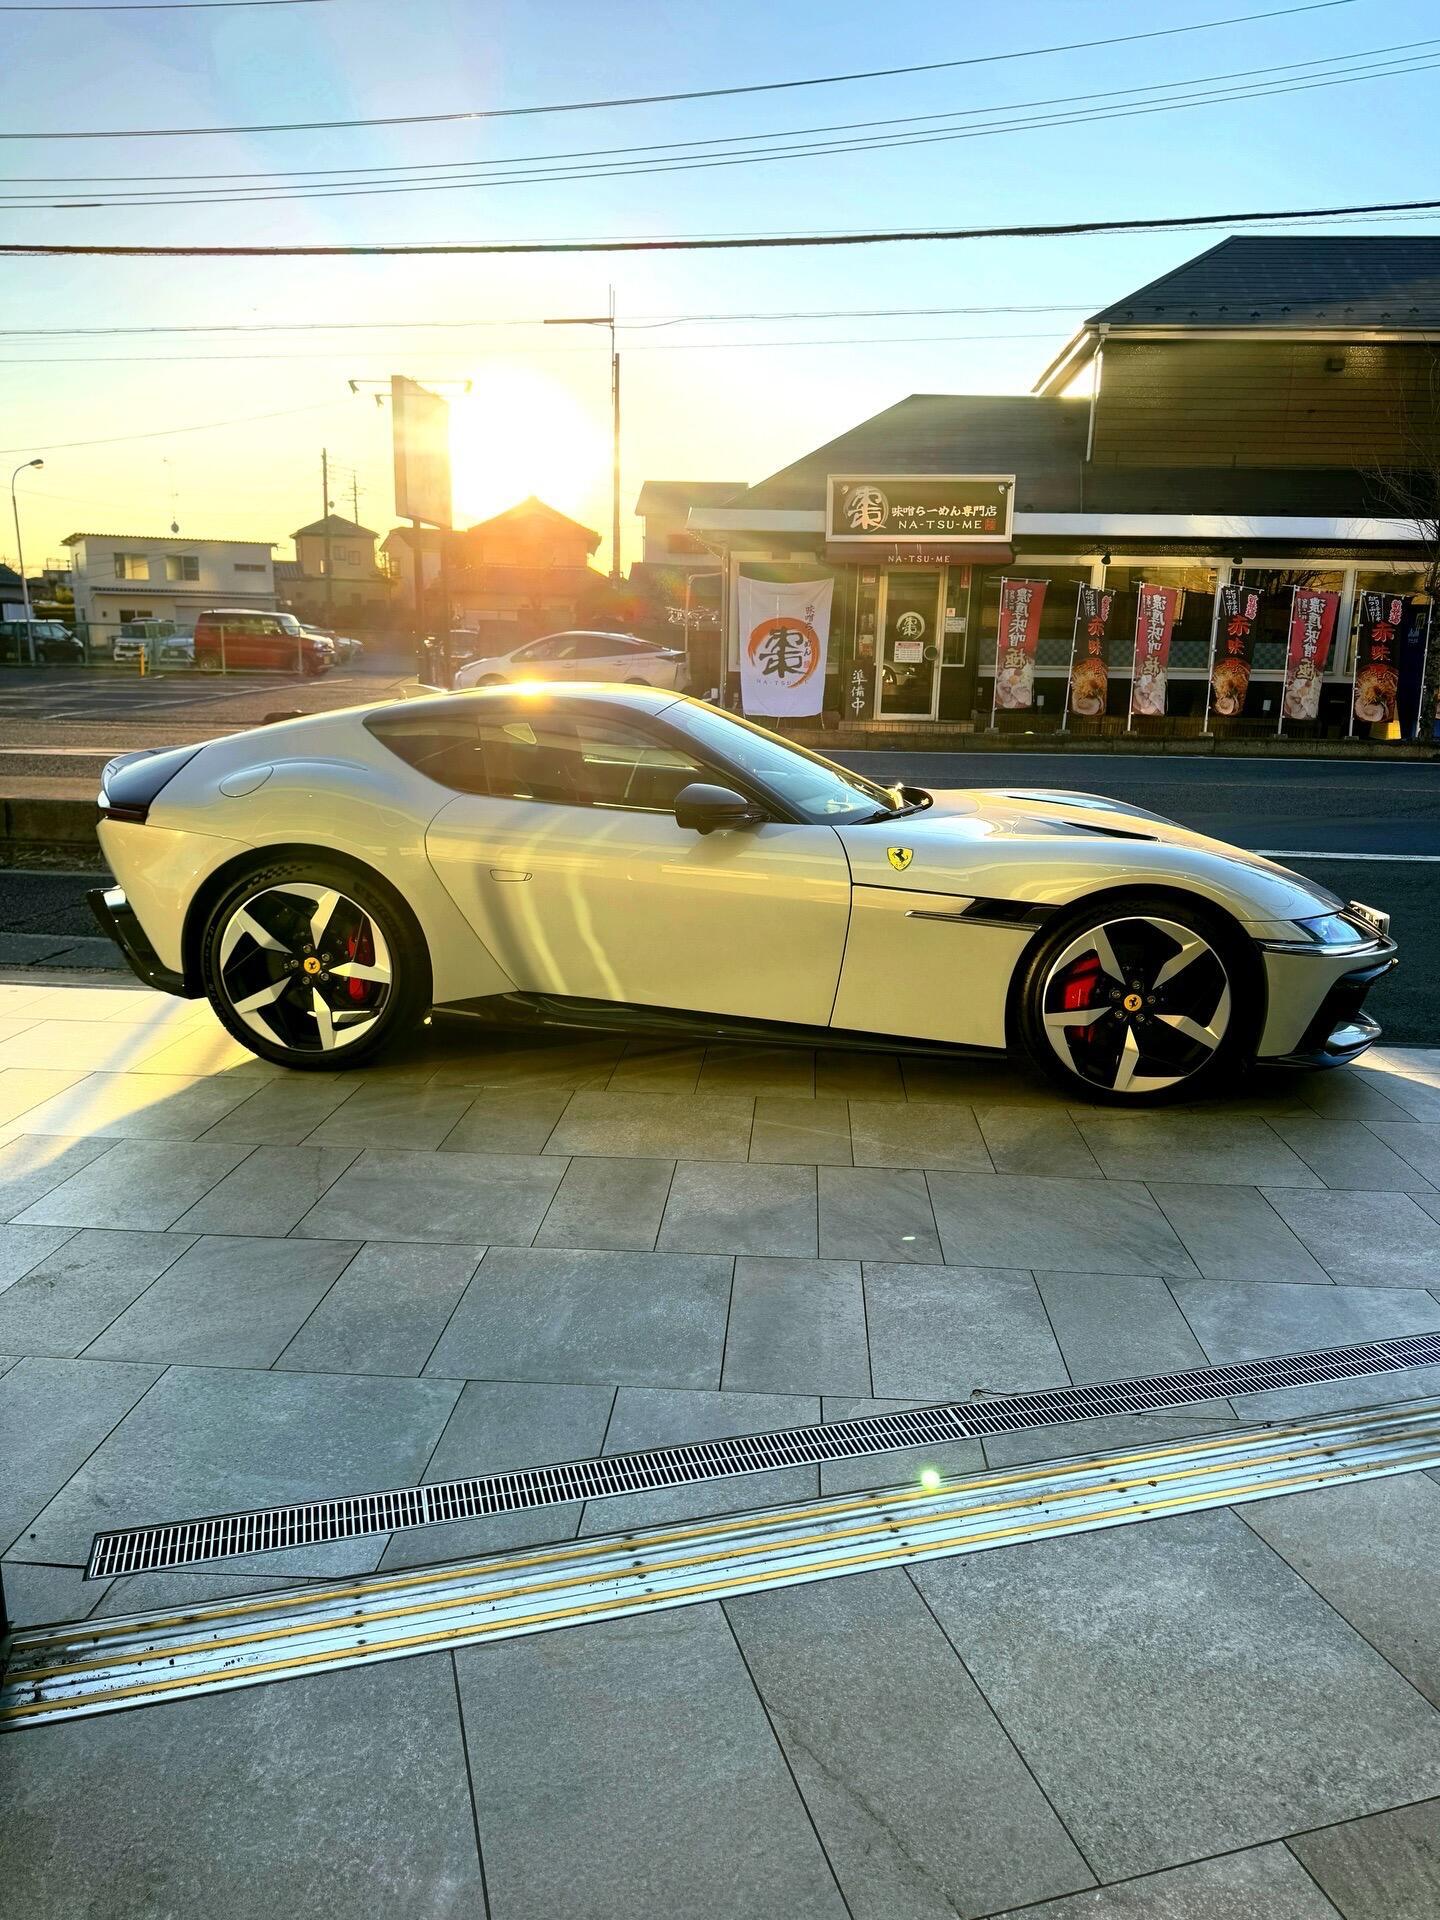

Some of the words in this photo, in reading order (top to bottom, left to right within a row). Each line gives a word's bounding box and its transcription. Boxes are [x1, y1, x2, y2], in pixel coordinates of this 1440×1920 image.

[891, 505, 997, 518] 味噌らーめん専門店
[898, 520, 982, 530] NA-TSU-ME
[887, 555, 951, 563] NA-TSU-ME
[851, 669, 868, 717] 準備中
